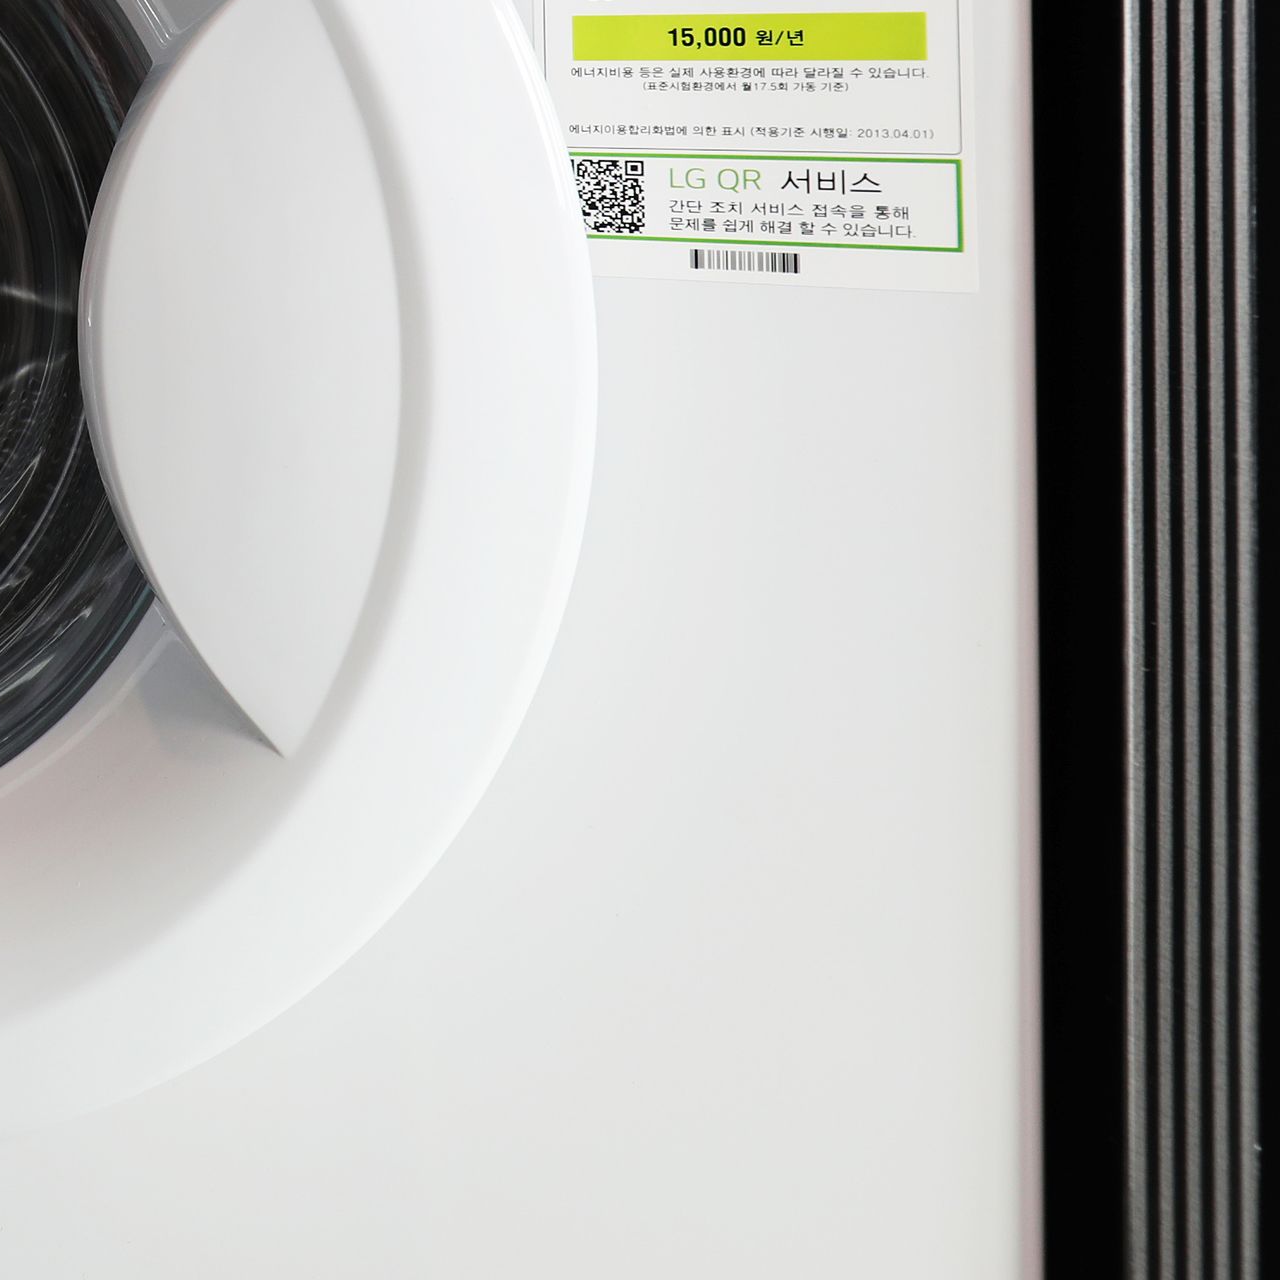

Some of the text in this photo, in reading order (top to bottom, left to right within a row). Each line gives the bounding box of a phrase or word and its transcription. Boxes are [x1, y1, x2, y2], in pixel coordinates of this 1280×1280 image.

[668, 27, 805, 49] 15,000 원/년
[570, 66, 930, 79] 에너지비용 등은 실제 사용환경에 따라 달라질 수 있습니다.
[820, 82, 849, 92] 기준)
[568, 124, 688, 136] 에너지이용합리화법에
[692, 125, 717, 136] 의한
[721, 126, 746, 137] 표시
[750, 126, 805, 138] (적용기준
[857, 128, 935, 139] 2013.04.01)
[669, 167, 882, 195] LG QR 서비스
[669, 199, 909, 220] 간단 조치 서비스 접속을 통해
[669, 217, 916, 238] 문제를 쉽게 해결 할 수 있습니다.
